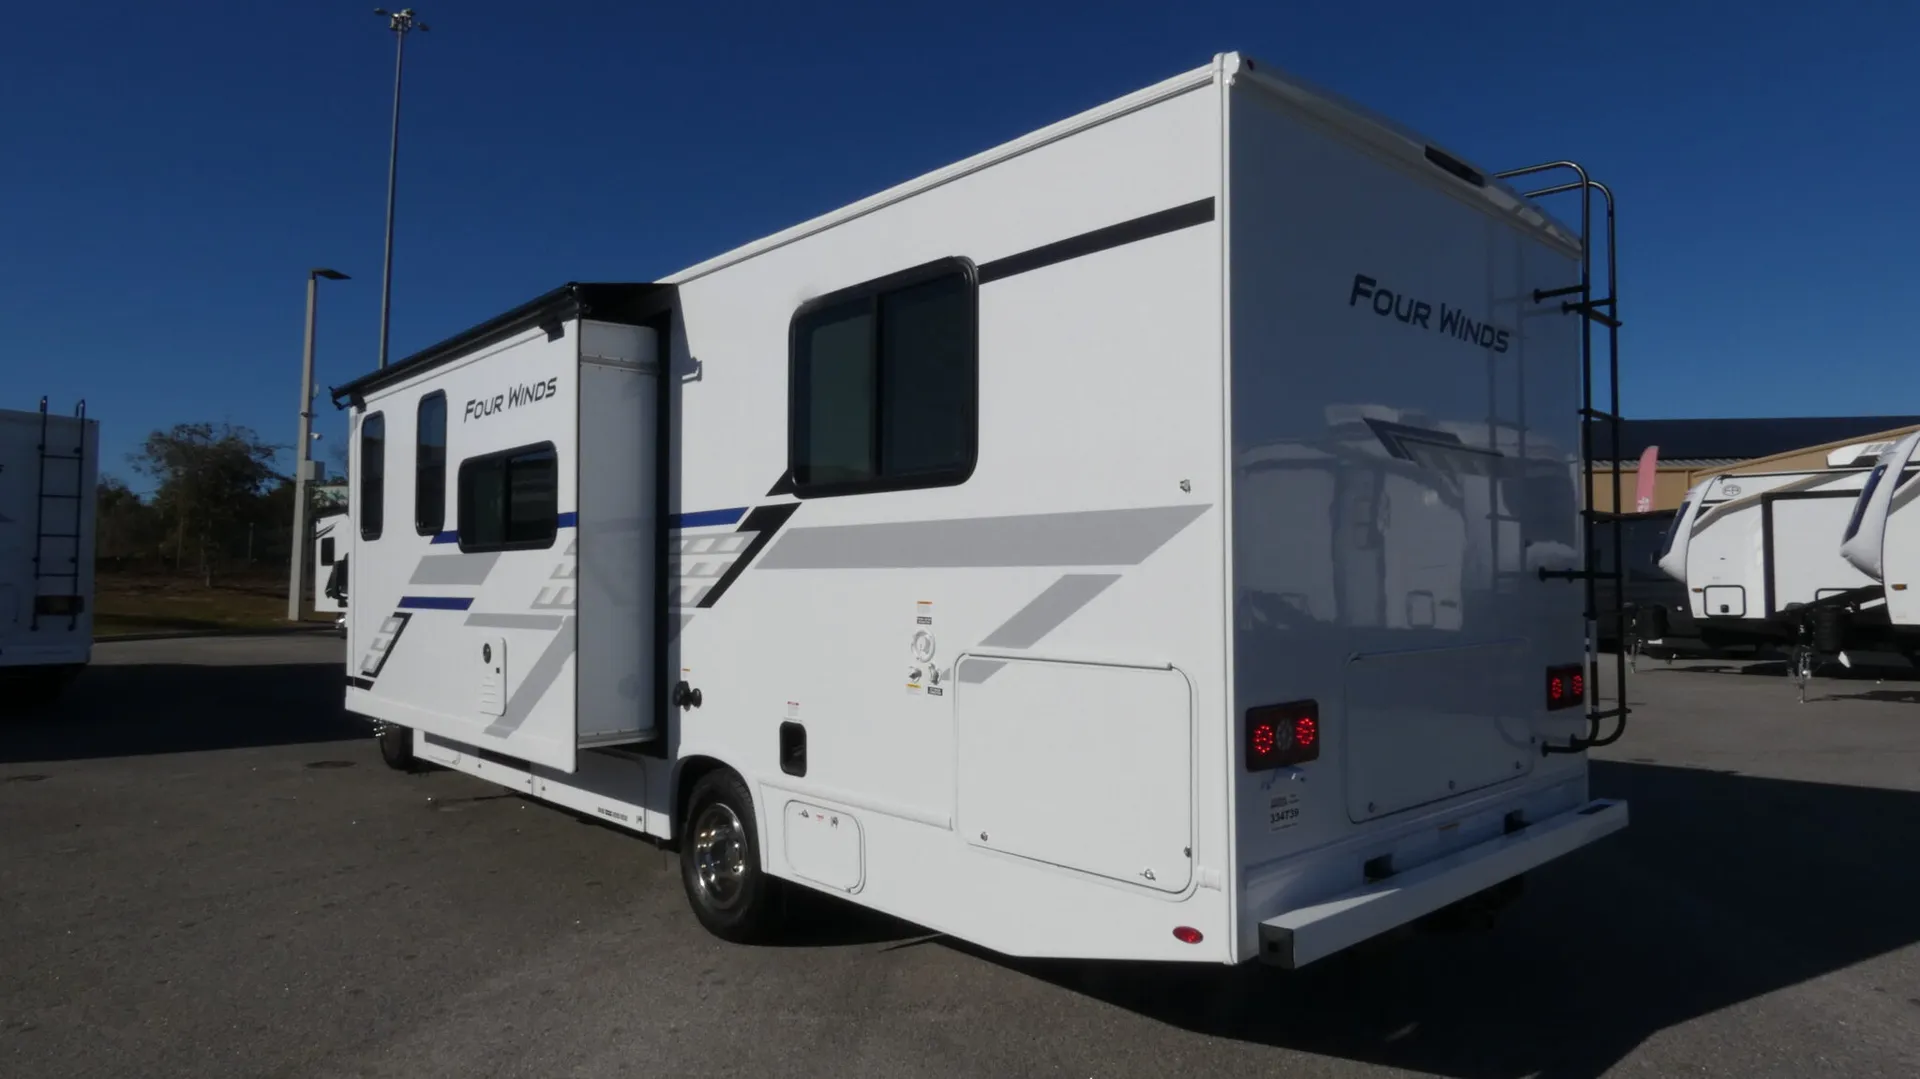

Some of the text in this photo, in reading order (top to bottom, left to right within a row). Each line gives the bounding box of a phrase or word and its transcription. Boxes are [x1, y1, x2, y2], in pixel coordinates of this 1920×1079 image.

[1349, 273, 1510, 353] FOUR WINDS
[464, 377, 557, 423] FOUR WINDS
